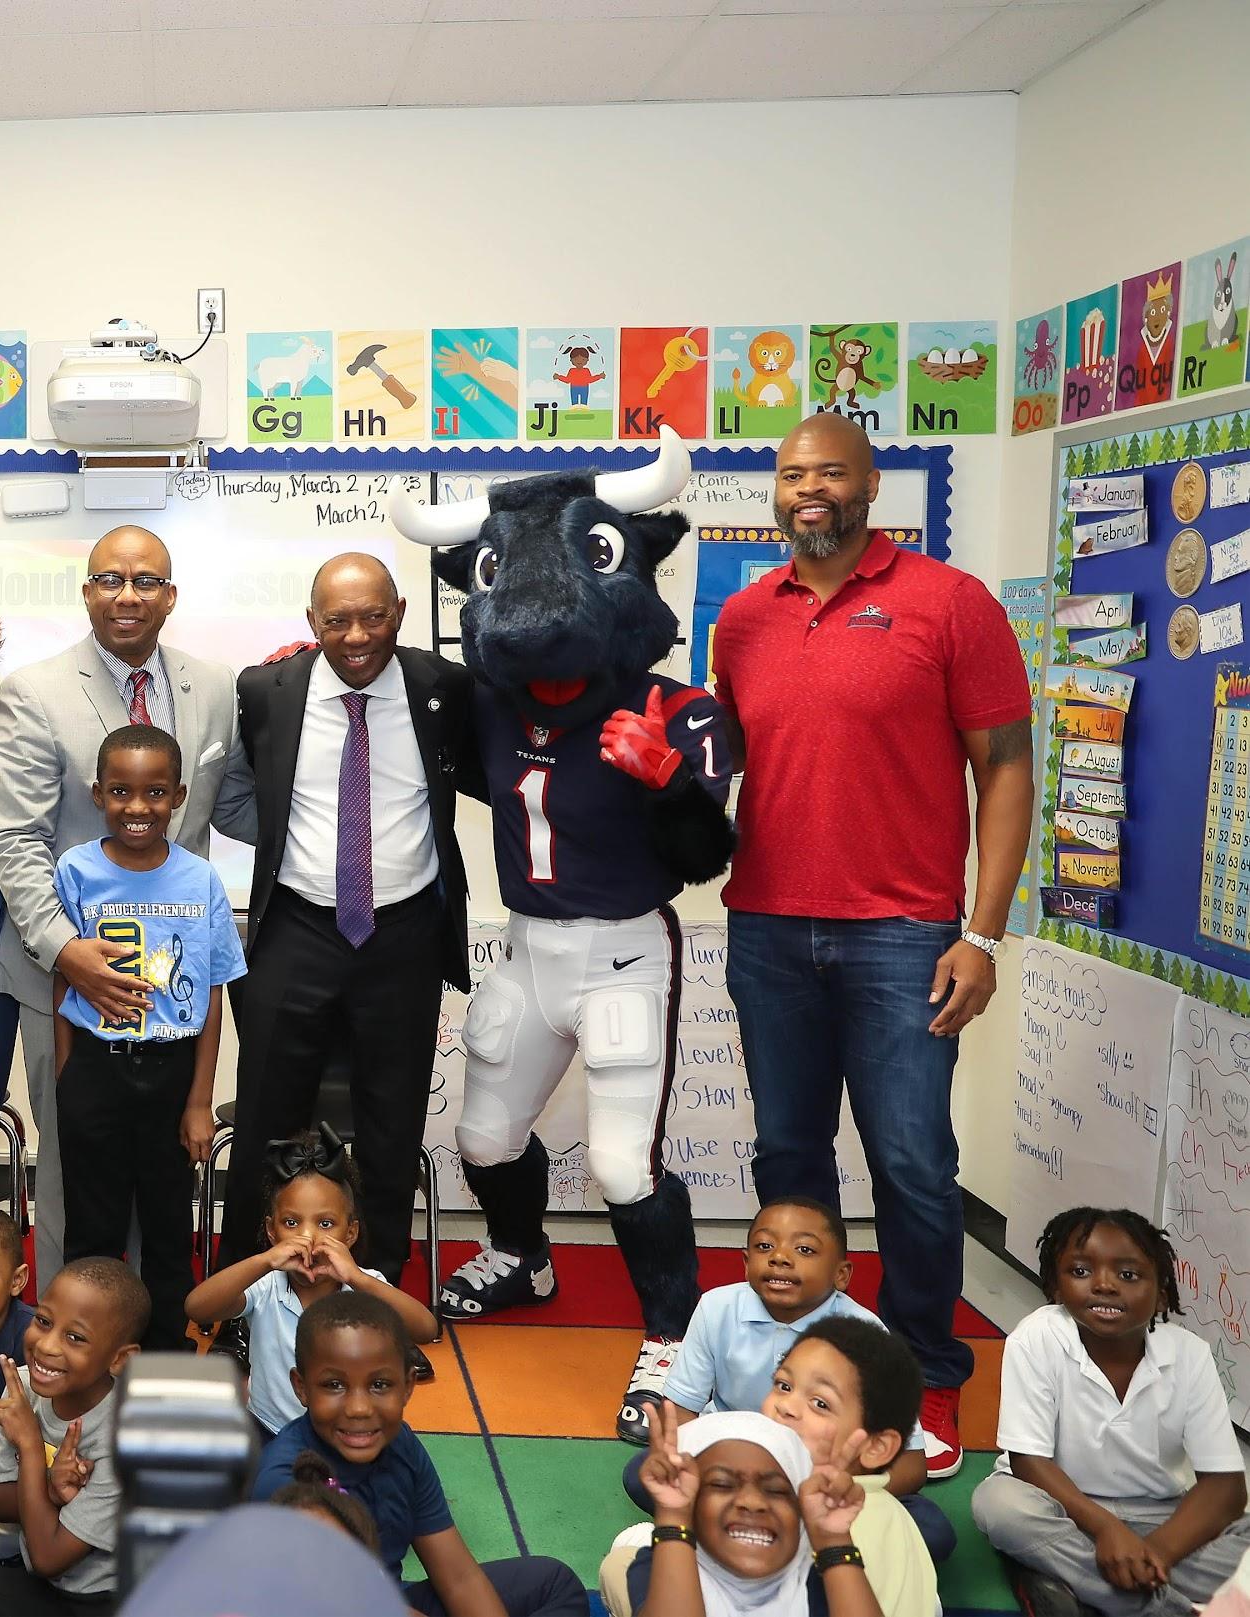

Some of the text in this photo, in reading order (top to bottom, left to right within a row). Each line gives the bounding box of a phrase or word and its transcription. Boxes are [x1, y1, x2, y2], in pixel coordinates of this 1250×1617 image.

[1118, 359, 1173, 394] Qu qu
[1182, 355, 1207, 391] Rr
[1065, 382, 1090, 417] Pp
[252, 404, 302, 438] Gg
[344, 408, 386, 438] Hh
[434, 407, 459, 436] Ii
[530, 402, 559, 438] Jj
[624, 406, 664, 434] Kk
[719, 404, 740, 434] Ll
[912, 403, 958, 431] Nn
[1015, 400, 1042, 430] Oo
[180, 476, 205, 487] Today
[189, 486, 199, 494] is
[291, 474, 340, 496] March
[698, 474, 739, 488] Coins
[687, 490, 699, 503] of
[704, 490, 734, 503] the
[736, 487, 768, 503] Day
[1098, 484, 1142, 507] January
[317, 501, 366, 526] March
[1003, 584, 1036, 600] 100 days
[1095, 600, 1125, 625] April
[1099, 638, 1124, 661] May
[1090, 676, 1115, 696] June
[1096, 711, 1115, 740] July
[1230, 714, 1235, 727] 2
[1242, 716, 1248, 728] 3
[701, 734, 719, 778] 1
[1227, 737, 1235, 750] 12
[1239, 739, 1247, 752] 13
[516, 751, 556, 764] TEXANS
[1085, 748, 1120, 774] August
[1213, 759, 1247, 775] 21 22 23
[1211, 782, 1246, 798] 31 32 33
[514, 766, 556, 883] 1
[1210, 805, 1245, 822] 41 42 43
[1207, 827, 1242, 846] 51 52 53
[1205, 850, 1250, 873] 61 62 63 64
[1204, 872, 1249, 896] 71 72 73 74
[83, 903, 206, 920] B.K. BRUCE ELEMENTARY
[1063, 892, 1097, 912] Dece
[1203, 894, 1247, 919] 81 82 83 84
[1202, 917, 1246, 942] 91 92 93 94
[1063, 980, 1095, 1010] traits
[152, 1025, 176, 1039] FINE
[1026, 1007, 1050, 1049] happy
[678, 1038, 735, 1066] Level
[682, 1077, 735, 1109] Stay
[1186, 1069, 1211, 1116] th
[1017, 1100, 1032, 1127] tired
[1055, 1099, 1082, 1132] grumpy
[677, 1137, 718, 1163] Use
[1016, 1133, 1050, 1172] demanding
[1222, 1317, 1241, 1340] ring
